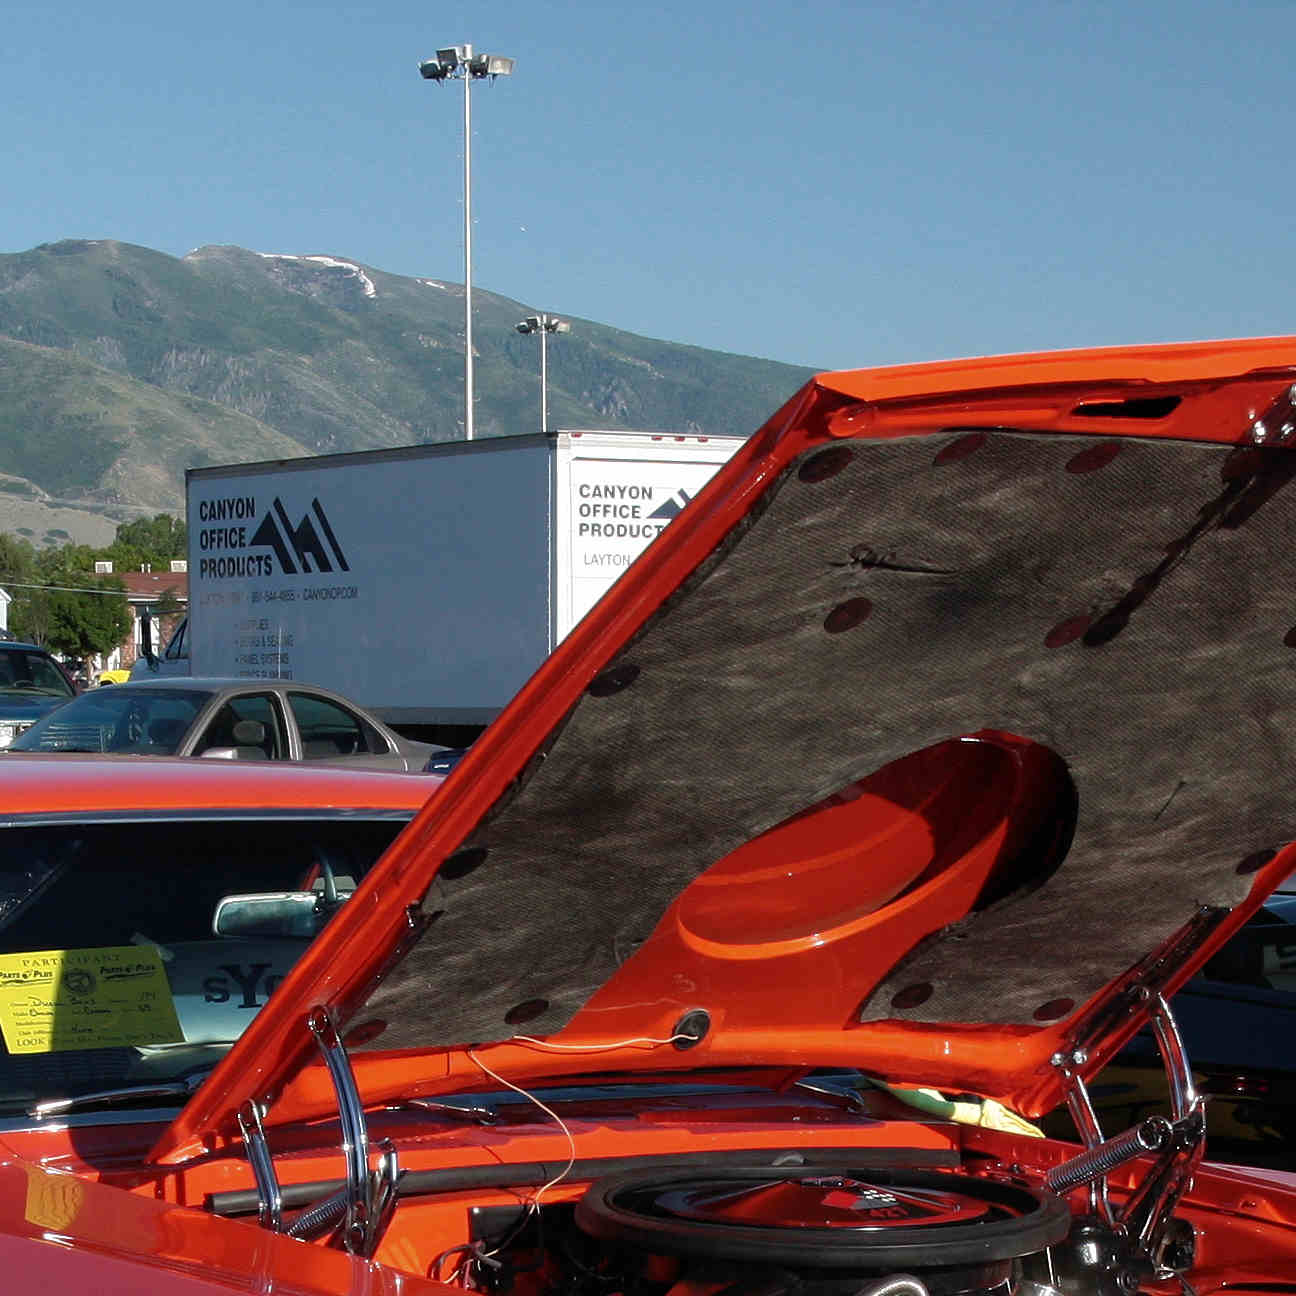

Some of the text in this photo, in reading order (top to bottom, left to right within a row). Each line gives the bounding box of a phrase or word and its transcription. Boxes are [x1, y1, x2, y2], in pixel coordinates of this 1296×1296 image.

[579, 483, 653, 500] CANYON
[200, 498, 256, 521] CANYON
[579, 503, 642, 519] OFFICE
[200, 527, 246, 550] OFFICE
[578, 523, 664, 538] PRODUCT
[200, 554, 273, 579] PRODUCTS
